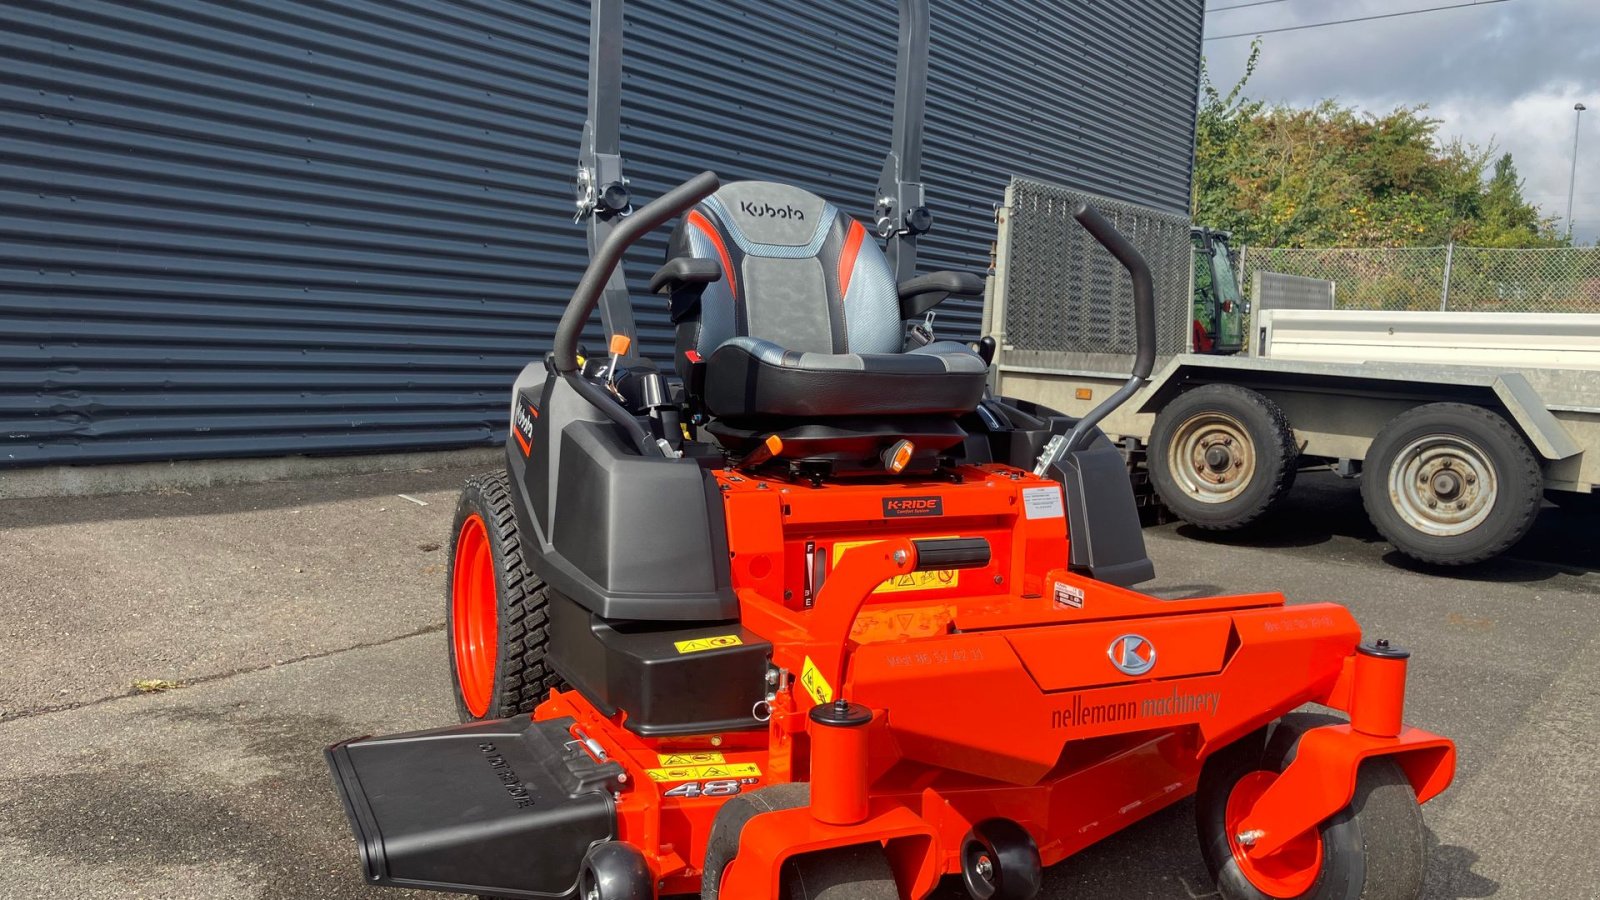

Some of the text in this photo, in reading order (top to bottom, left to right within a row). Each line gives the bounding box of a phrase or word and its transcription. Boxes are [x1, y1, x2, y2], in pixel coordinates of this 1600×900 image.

[740, 201, 805, 220] Kubota
[887, 499, 938, 510] K-RIDE
[807, 544, 813, 552] F
[805, 598, 811, 606] E
[1051, 684, 1222, 729] nellemann machinery
